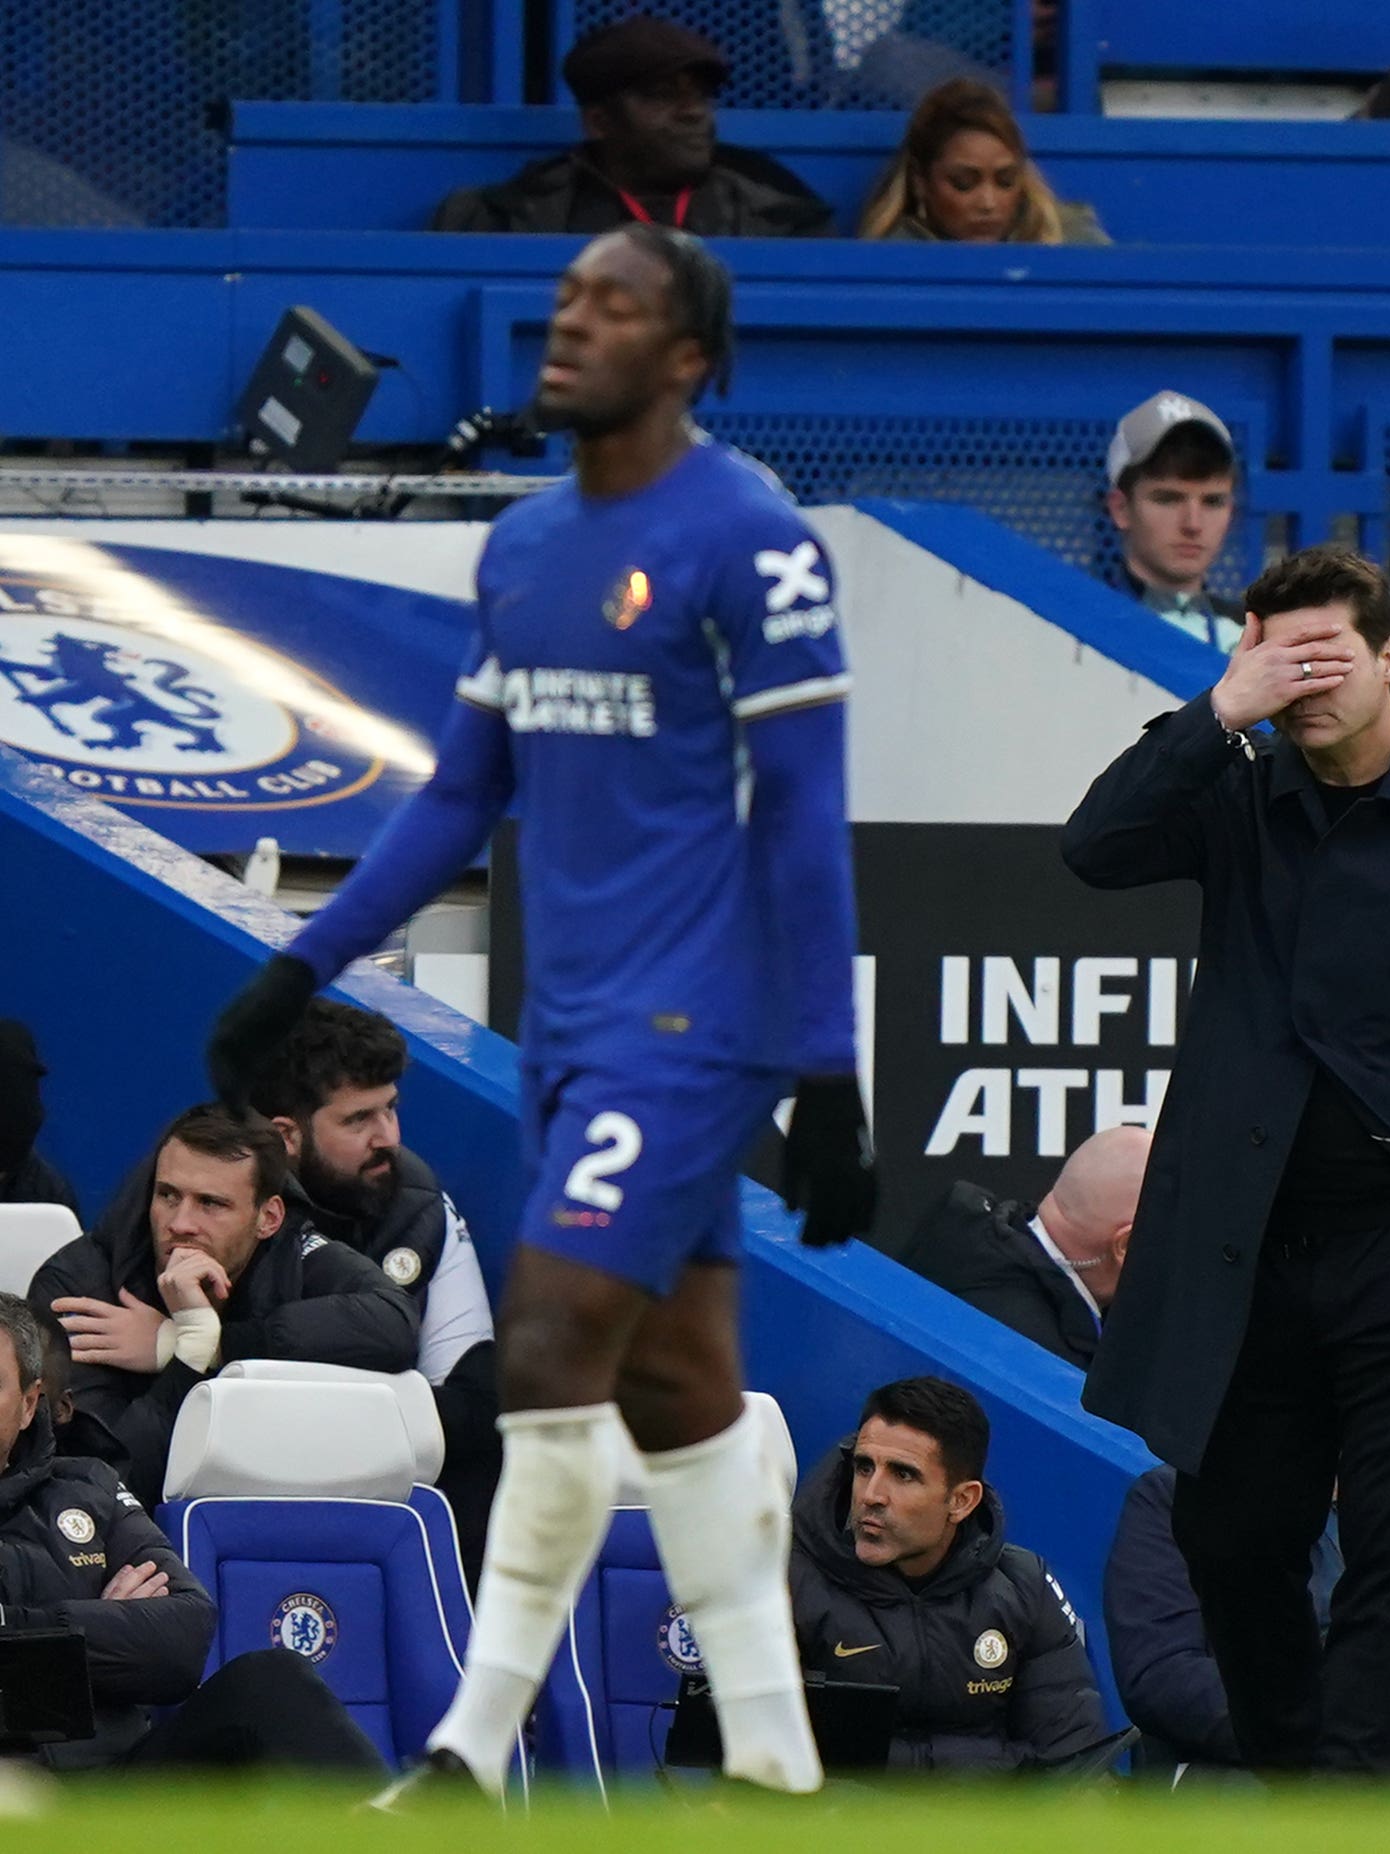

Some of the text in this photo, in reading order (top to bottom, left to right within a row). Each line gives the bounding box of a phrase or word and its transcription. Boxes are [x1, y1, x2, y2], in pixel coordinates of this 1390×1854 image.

[940, 956, 1198, 1046] INFI
[924, 1068, 1172, 1157] ATH
[564, 1110, 642, 1213] 2
[69, 1552, 106, 1568] trivag
[282, 1597, 324, 1613] CHELSEA
